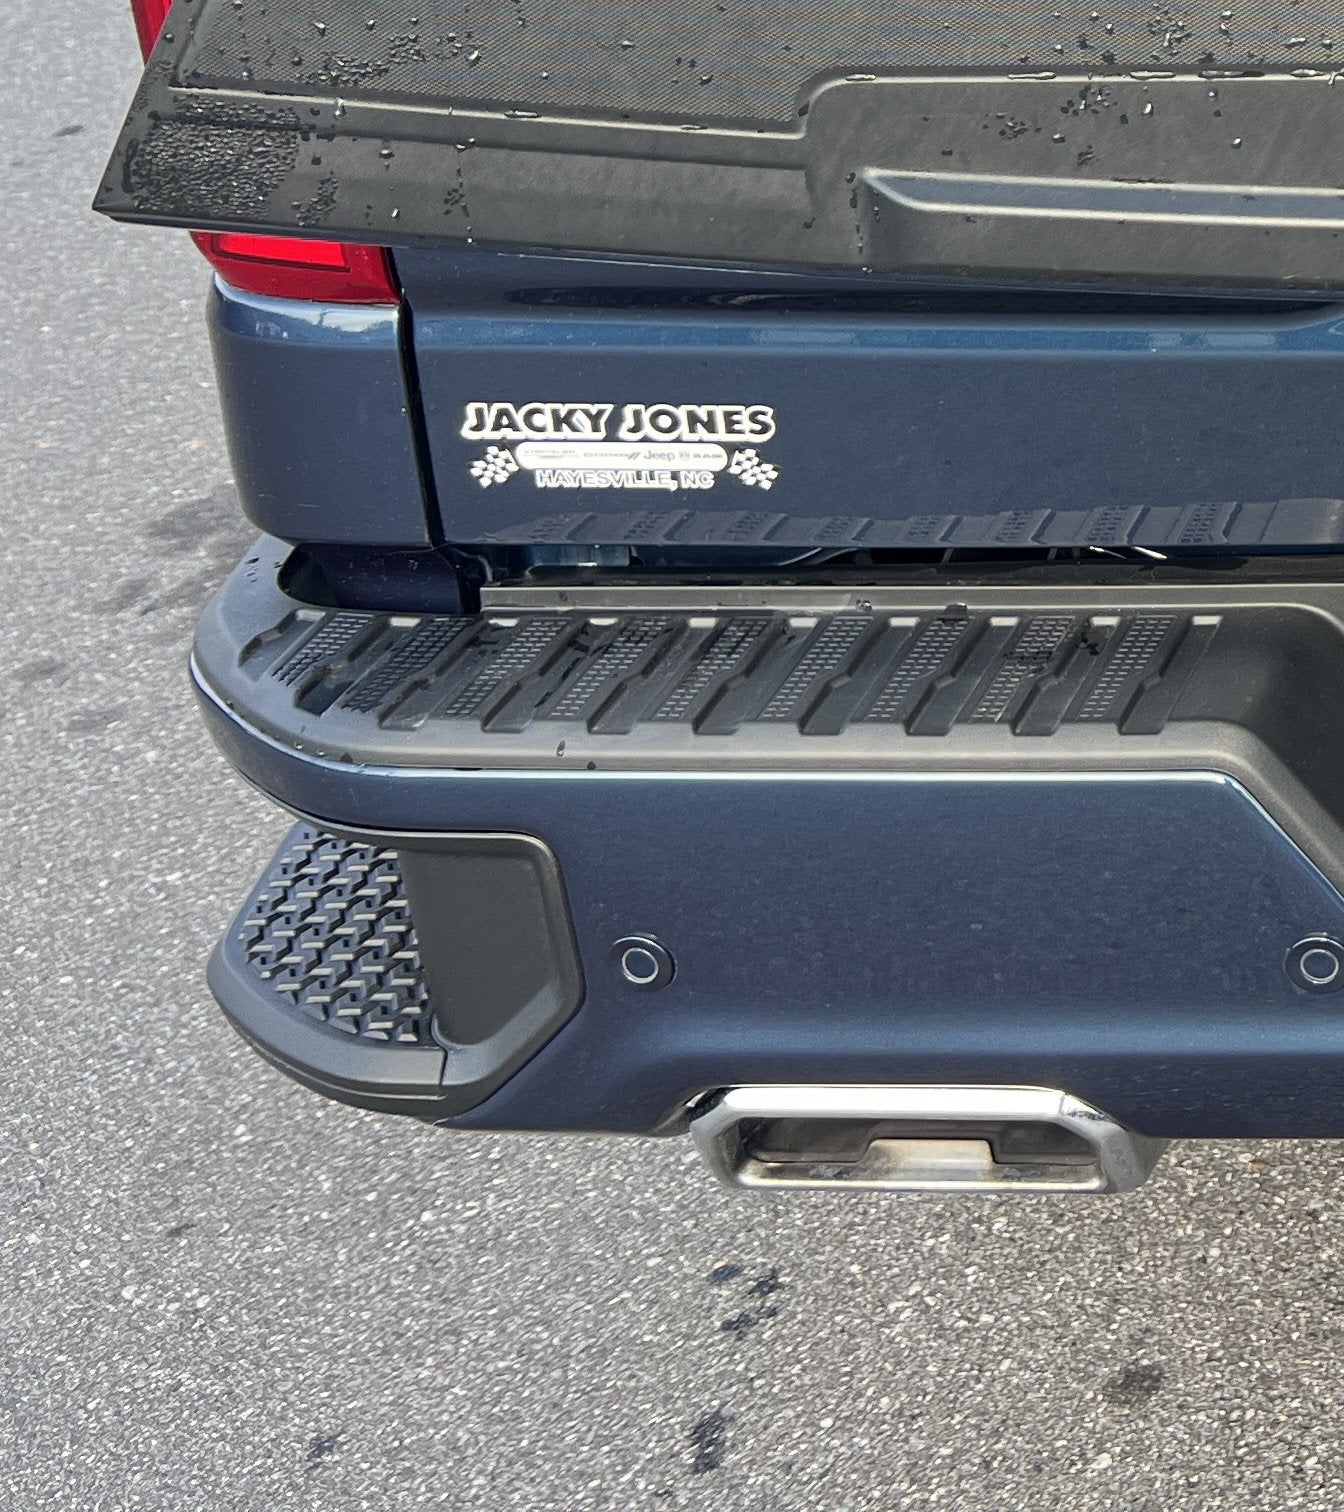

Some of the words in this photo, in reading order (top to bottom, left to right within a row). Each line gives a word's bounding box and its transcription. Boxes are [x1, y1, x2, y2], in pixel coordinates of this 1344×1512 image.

[461, 402, 615, 440] JACKY
[618, 403, 776, 443] JONES
[643, 449, 676, 462] Jeep
[535, 469, 679, 492] HAYESVILLE,
[679, 471, 716, 489] NC
